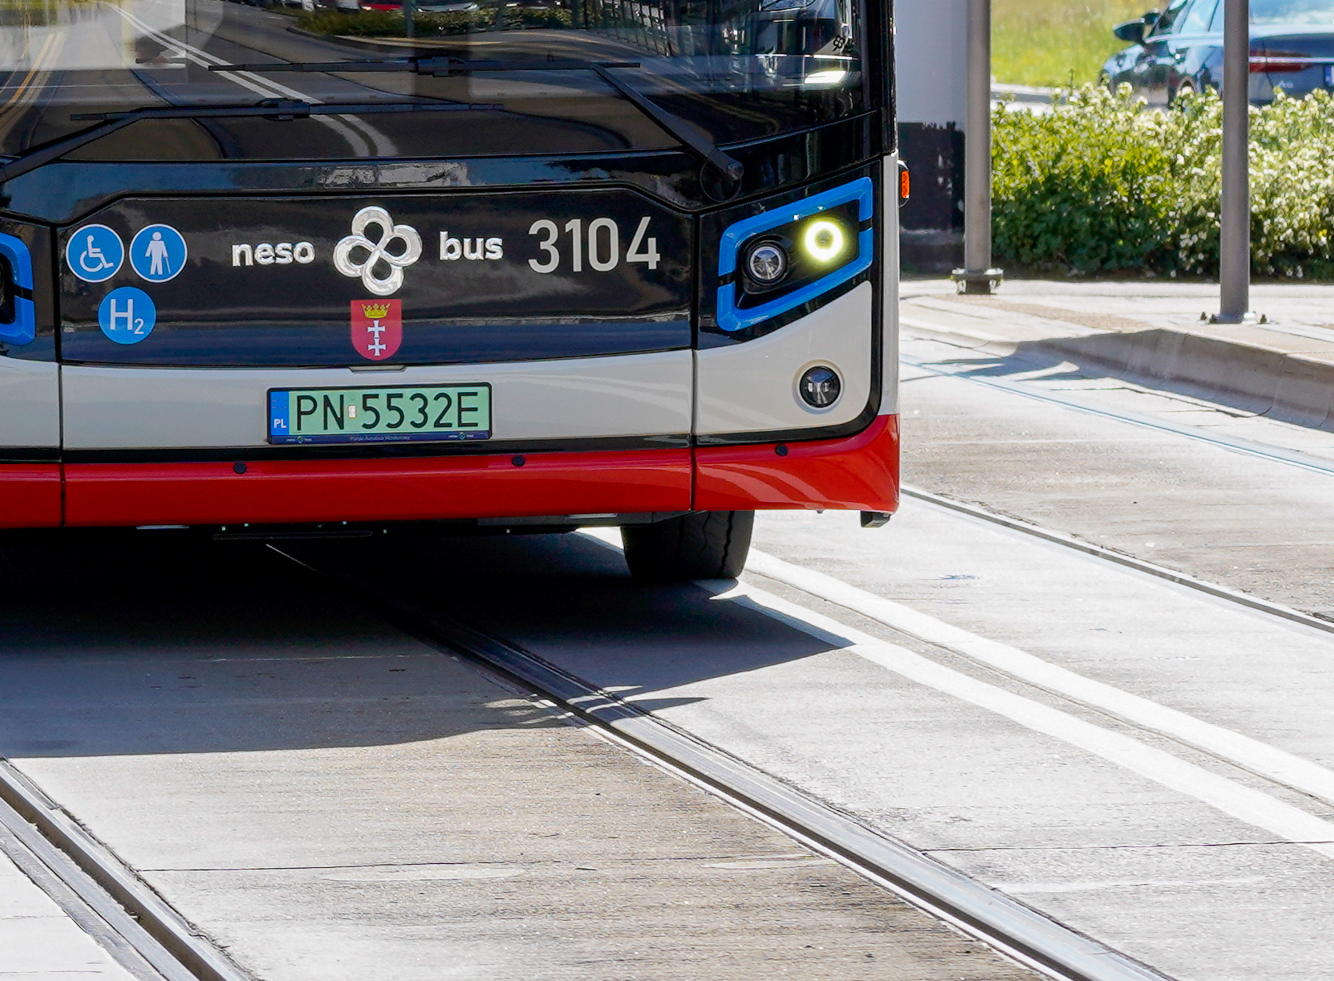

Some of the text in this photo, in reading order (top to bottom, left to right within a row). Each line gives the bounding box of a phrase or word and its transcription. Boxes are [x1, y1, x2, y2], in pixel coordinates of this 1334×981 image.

[232, 216, 661, 274] neso bus 3104
[273, 418, 287, 429] PL
[296, 391, 479, 431] PN 5532E
